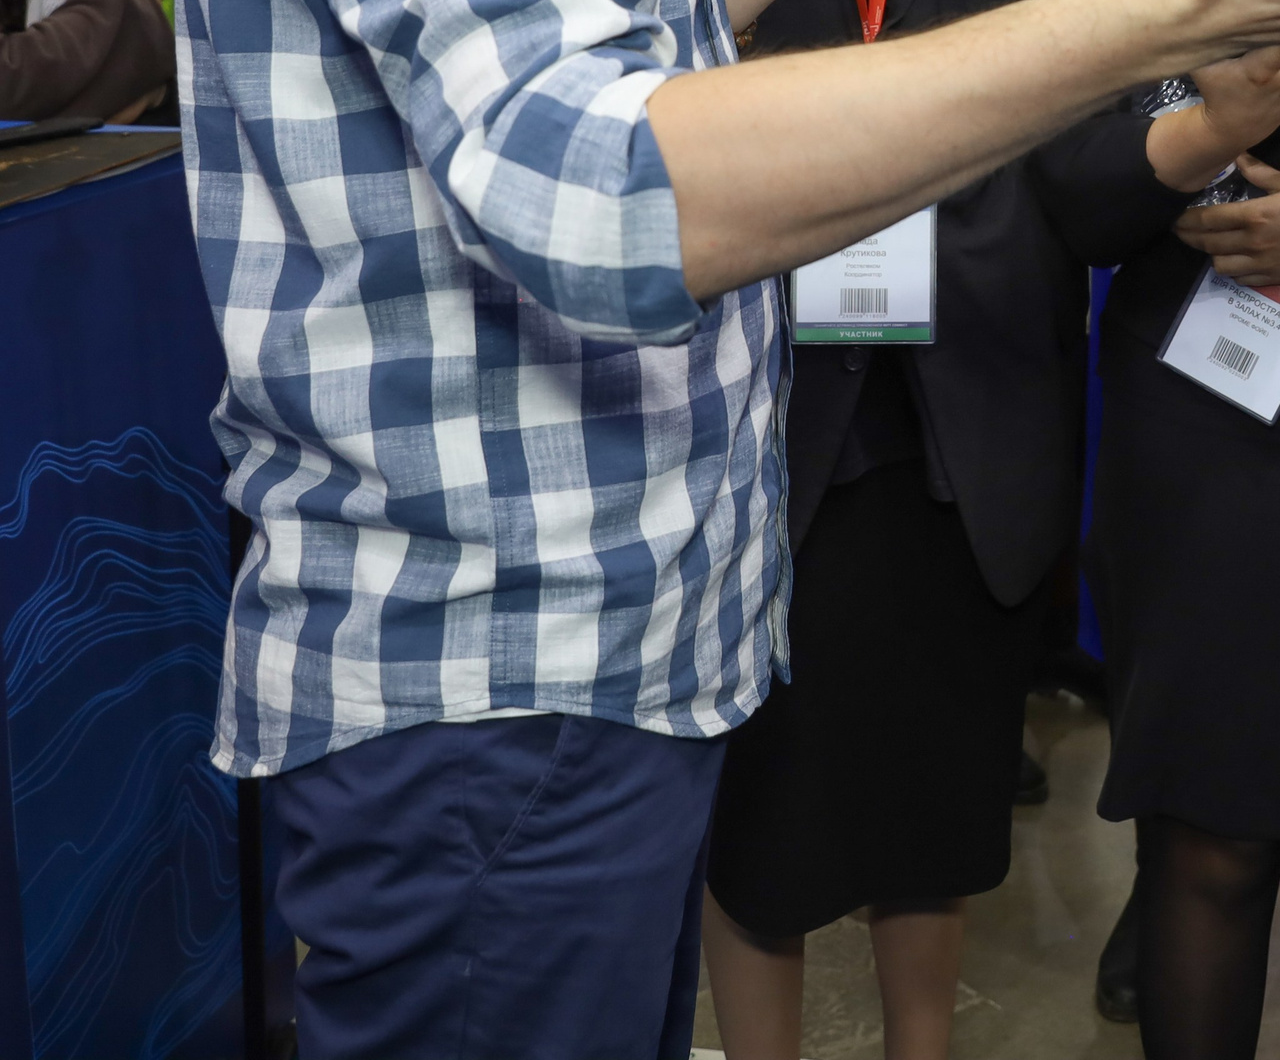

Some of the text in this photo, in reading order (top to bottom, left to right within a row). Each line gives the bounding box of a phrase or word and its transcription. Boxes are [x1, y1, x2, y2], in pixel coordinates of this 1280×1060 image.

[840, 249, 887, 258] Крутикова
[1211, 276, 1229, 289] ДЛЯ
[1227, 297, 1234, 305] В
[1235, 300, 1261, 320] ЗАЛАХ
[1229, 312, 1250, 327] (КРОМЕ
